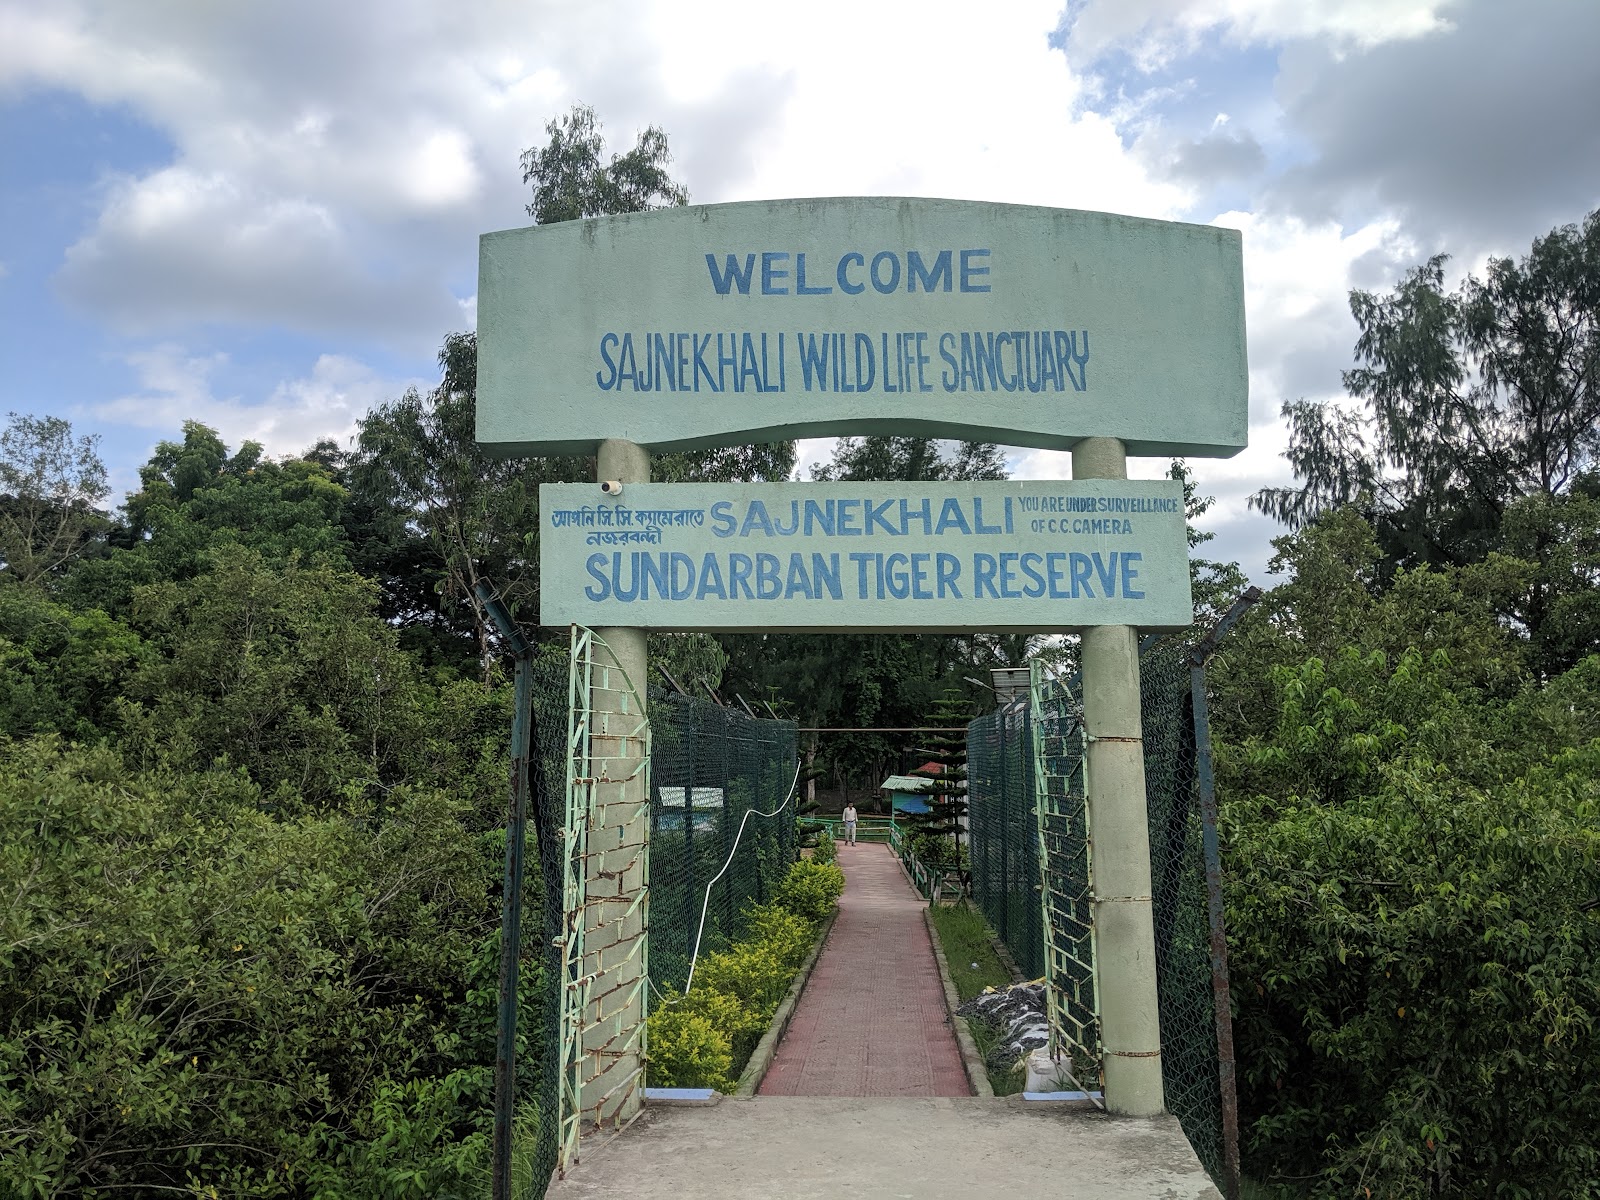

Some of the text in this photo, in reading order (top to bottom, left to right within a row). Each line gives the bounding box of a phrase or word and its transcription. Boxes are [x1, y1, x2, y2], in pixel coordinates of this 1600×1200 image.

[705, 248, 992, 296] WELCOME
[595, 330, 1090, 394] SAJNEKHALI WILD LIFE SANCTUARY
[551, 505, 596, 527] আপনি
[710, 497, 1014, 538] SAJNEKHALI
[1018, 496, 1039, 512] YOU
[1041, 496, 1065, 512] ARE
[1066, 497, 1097, 513] UNDER
[586, 525, 663, 546] নজরবন্দী
[1031, 519, 1046, 533] OF
[584, 551, 1146, 603] SUNDARBAN TIGER RESERVE
